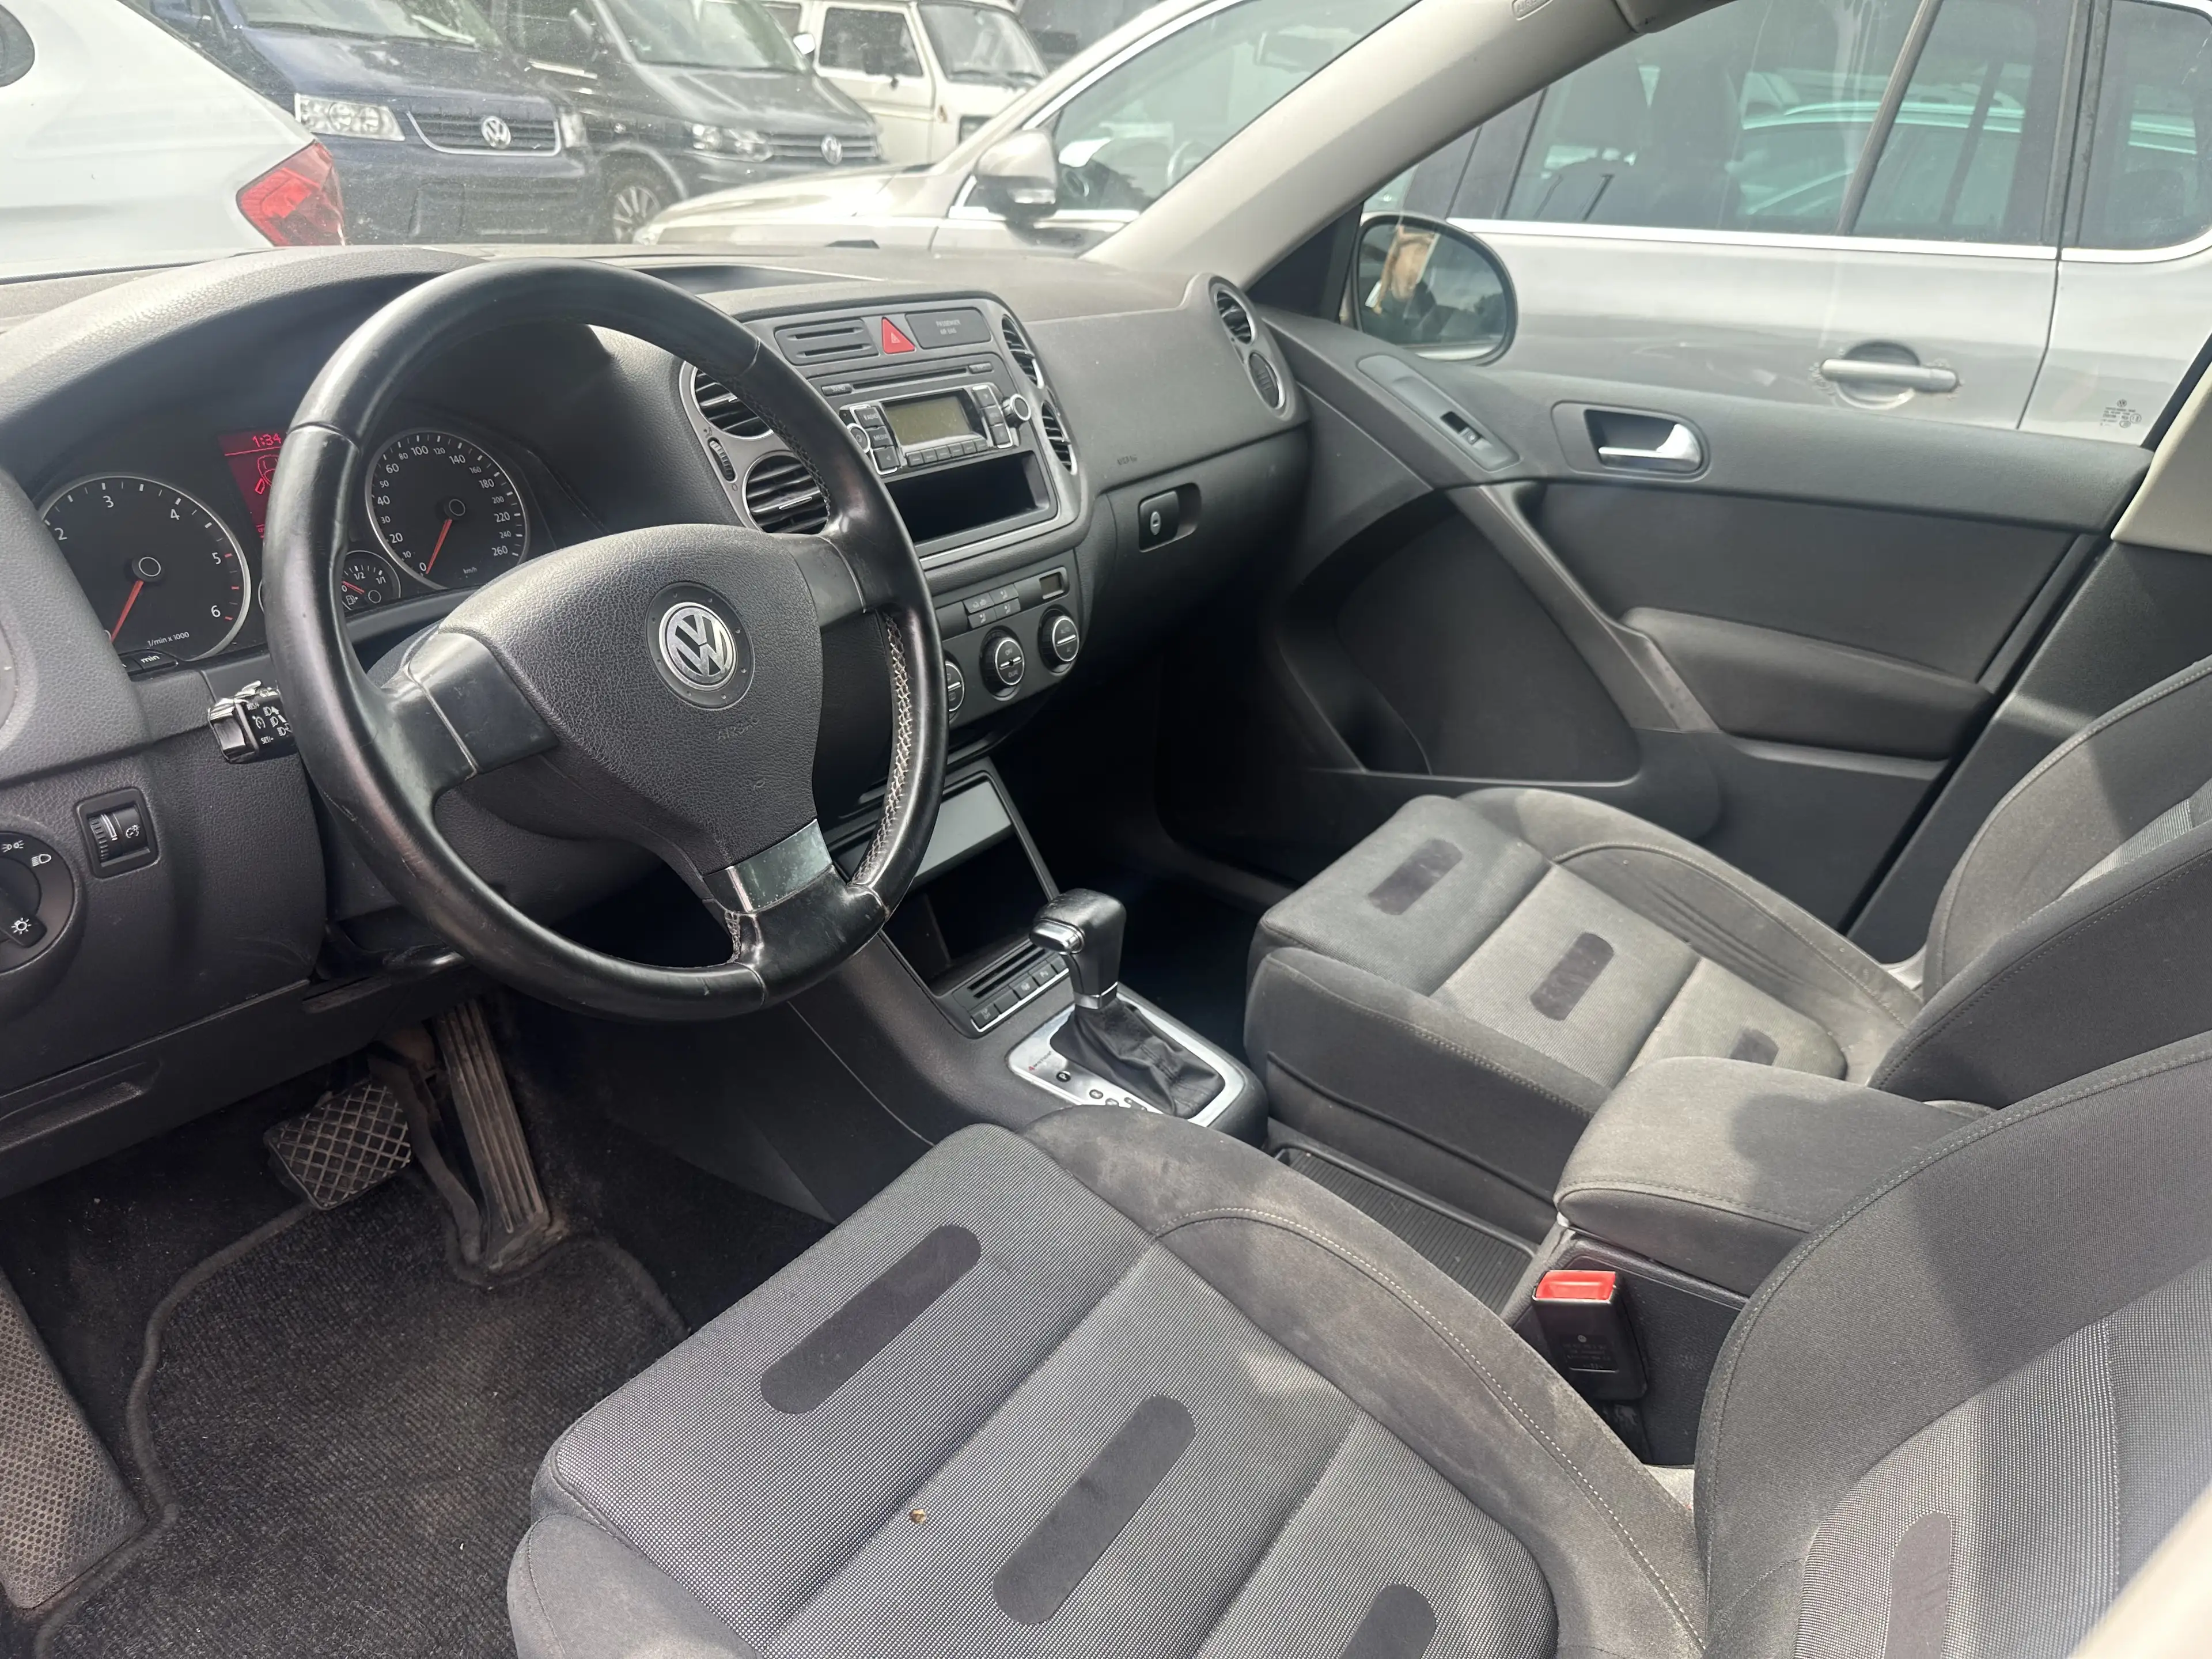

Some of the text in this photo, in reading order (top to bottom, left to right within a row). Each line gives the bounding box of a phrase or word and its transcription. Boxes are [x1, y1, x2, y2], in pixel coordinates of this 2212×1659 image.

[252, 433, 282, 447] 1:34
[411, 445, 429, 456] 100
[433, 447, 445, 455] 120
[449, 454, 465, 464] 140
[385, 463, 399, 474] 60
[469, 466, 482, 474] 160
[380, 480, 389, 488] 50
[479, 479, 494, 488] 180
[103, 496, 114, 507] 3
[377, 495, 390, 506] 40
[492, 496, 505, 504] 200
[170, 509, 180, 521] 4
[381, 516, 391, 524] 30
[494, 512, 510, 522] 220
[55, 528, 67, 540] 2
[389, 532, 403, 543] 20
[499, 531, 512, 539] 240
[403, 551, 411, 559] 10
[492, 546, 508, 558] 260
[212, 552, 221, 565] 5
[419, 562, 427, 571] 0
[354, 572, 366, 580] 1/2
[376, 576, 387, 584] 1/1
[211, 605, 221, 618] 6
[147, 637, 167, 647] 1/min
[173, 631, 190, 641] 1000
[661, 605, 734, 687] VW
[141, 655, 160, 663] min
